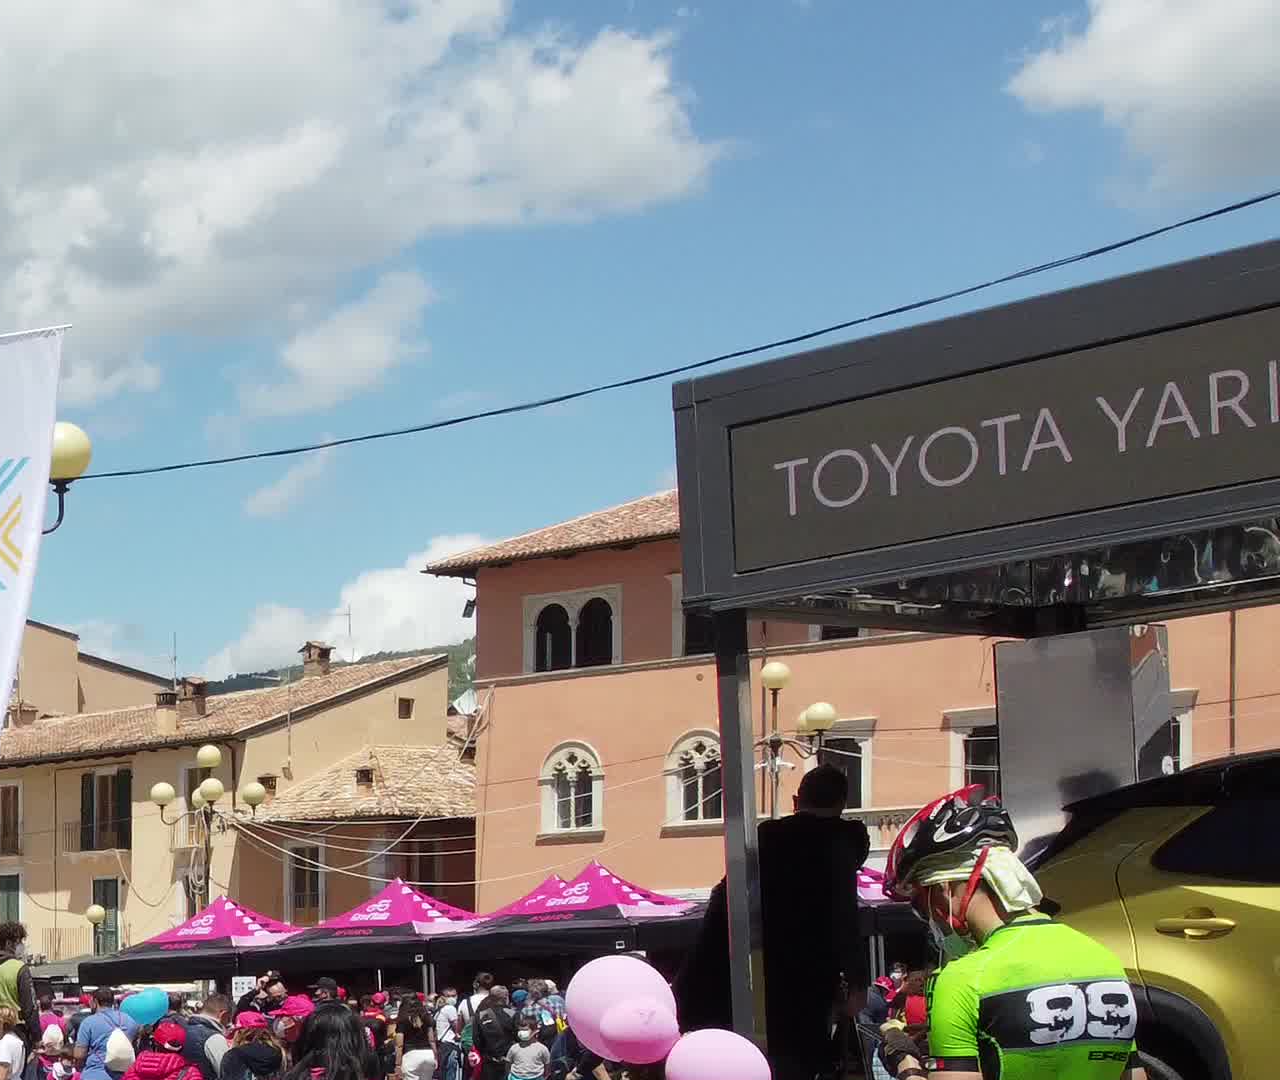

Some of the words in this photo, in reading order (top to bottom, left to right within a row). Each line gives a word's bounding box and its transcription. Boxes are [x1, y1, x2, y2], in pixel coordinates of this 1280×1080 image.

[773, 407, 1073, 517] TOYOTA
[1095, 359, 1280, 454] YARI
[1026, 981, 1137, 1045] 99
